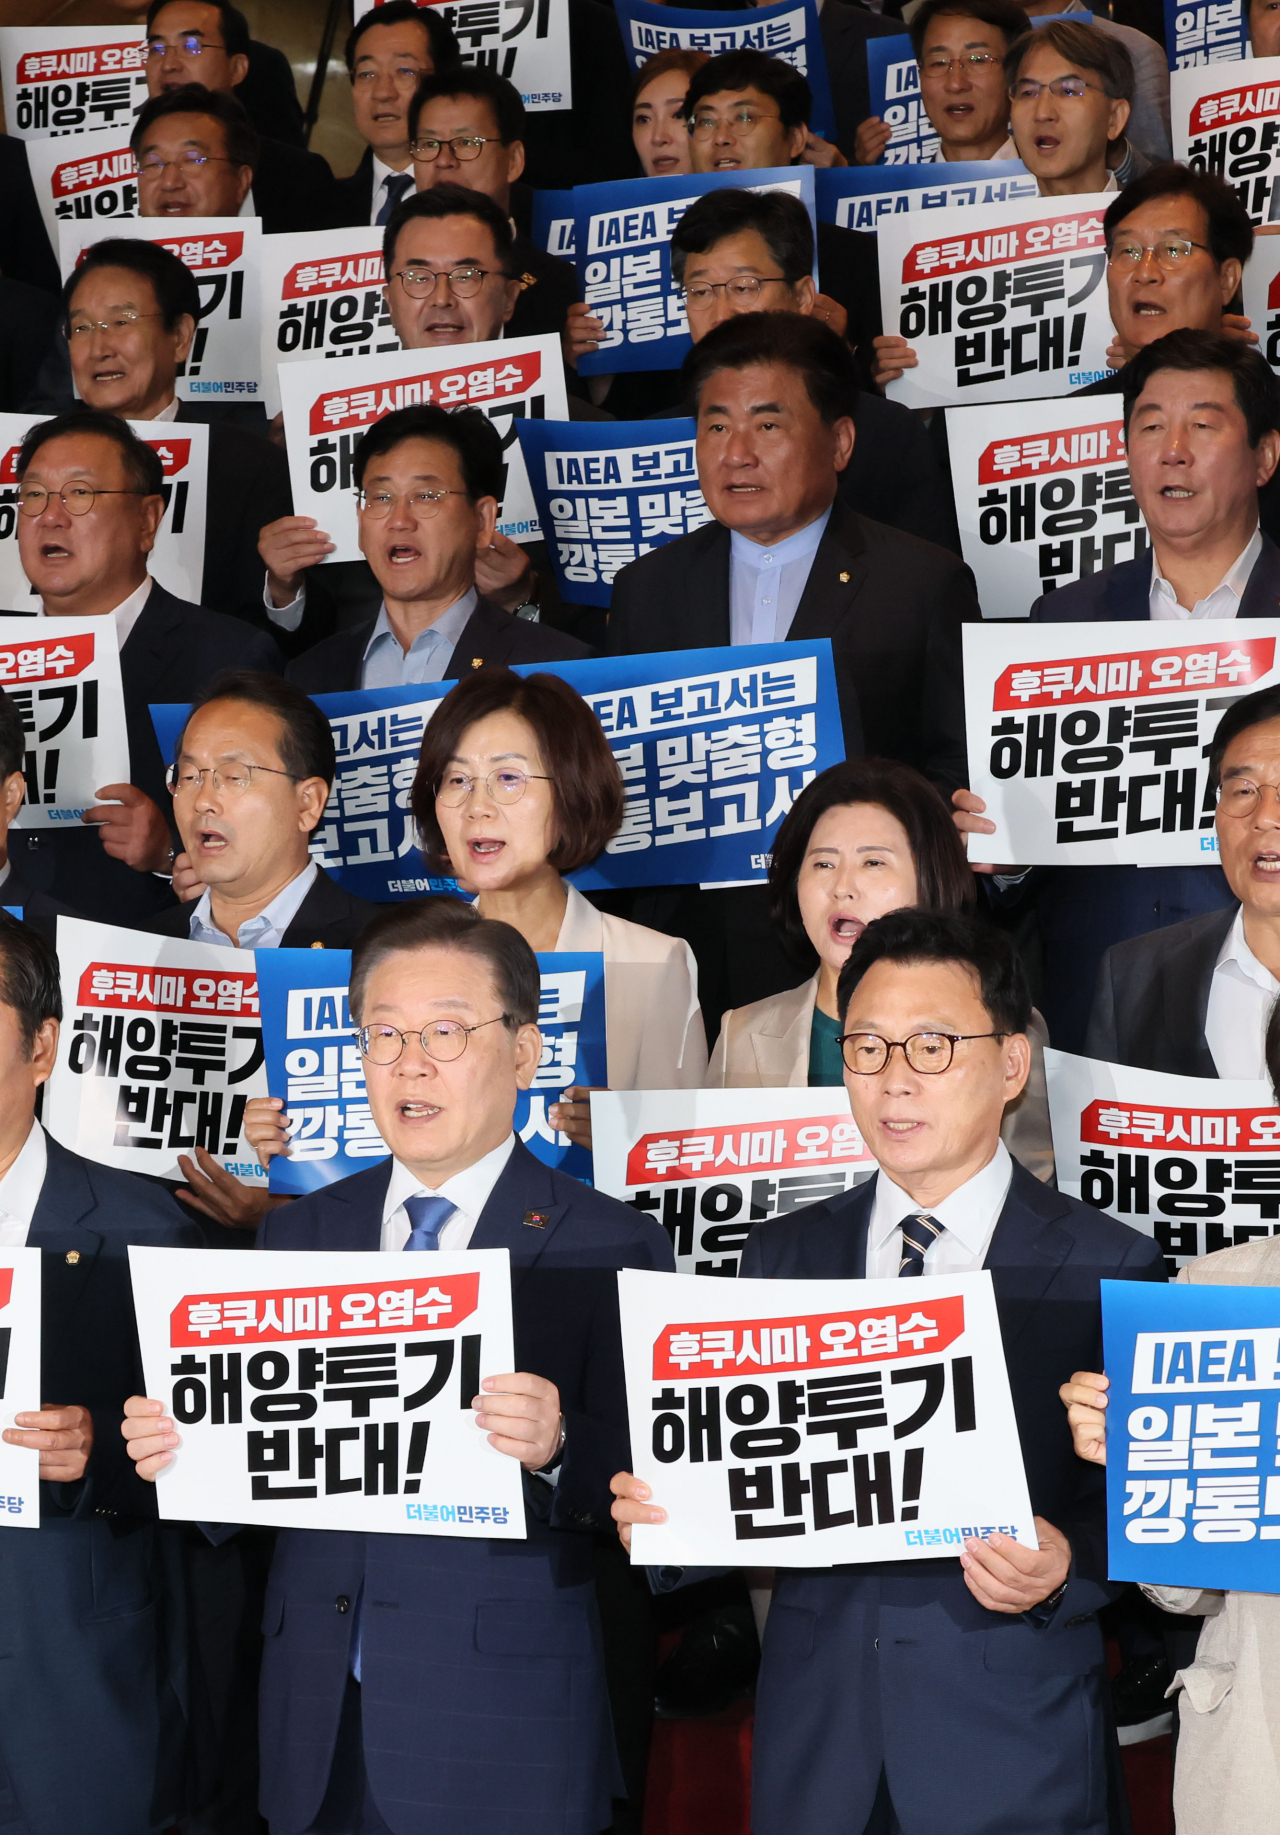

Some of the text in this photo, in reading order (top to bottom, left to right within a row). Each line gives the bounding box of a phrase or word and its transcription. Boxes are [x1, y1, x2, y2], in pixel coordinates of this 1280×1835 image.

[637, 26, 681, 51] IAEA
[1175, 0, 1242, 52] 일본
[24, 51, 97, 78] 후쿠시마
[597, 210, 657, 248] IAEA
[915, 217, 1104, 274] 후쿠시마 오염수
[584, 250, 661, 304] 일본
[277, 290, 393, 353] 해양
[954, 312, 1087, 388] 반대!
[189, 381, 259, 394] 더불어민주당
[322, 364, 523, 425] 후쿠시마 오염수
[556, 456, 622, 485] IAEA
[992, 429, 1111, 475] 후쿠시마
[549, 496, 632, 540] 일본
[557, 543, 658, 585] 깡통
[650, 671, 796, 726] 보고서는
[1009, 649, 1251, 702] 후쿠시마 오염수
[656, 711, 817, 790] 맞춤형
[90, 969, 187, 1007] 후쿠시마
[113, 1084, 248, 1155] 반대!
[1098, 1107, 1241, 1146] 후쿠시마
[645, 1128, 788, 1174] 후쿠시마
[187, 1285, 452, 1339] 후쿠시마 오염수
[668, 1311, 938, 1371] 후쿠시마 오염수
[1152, 1339, 1256, 1385] IAEA
[170, 1333, 482, 1425] 해양투기
[651, 1355, 977, 1464] 해양투기
[1126, 1401, 1261, 1471] 일본
[247, 1420, 431, 1500] 반대!
[405, 1503, 510, 1525] 더불어민주당
[727, 1446, 925, 1541] 반대!
[1122, 1475, 1280, 1544] 깡통
